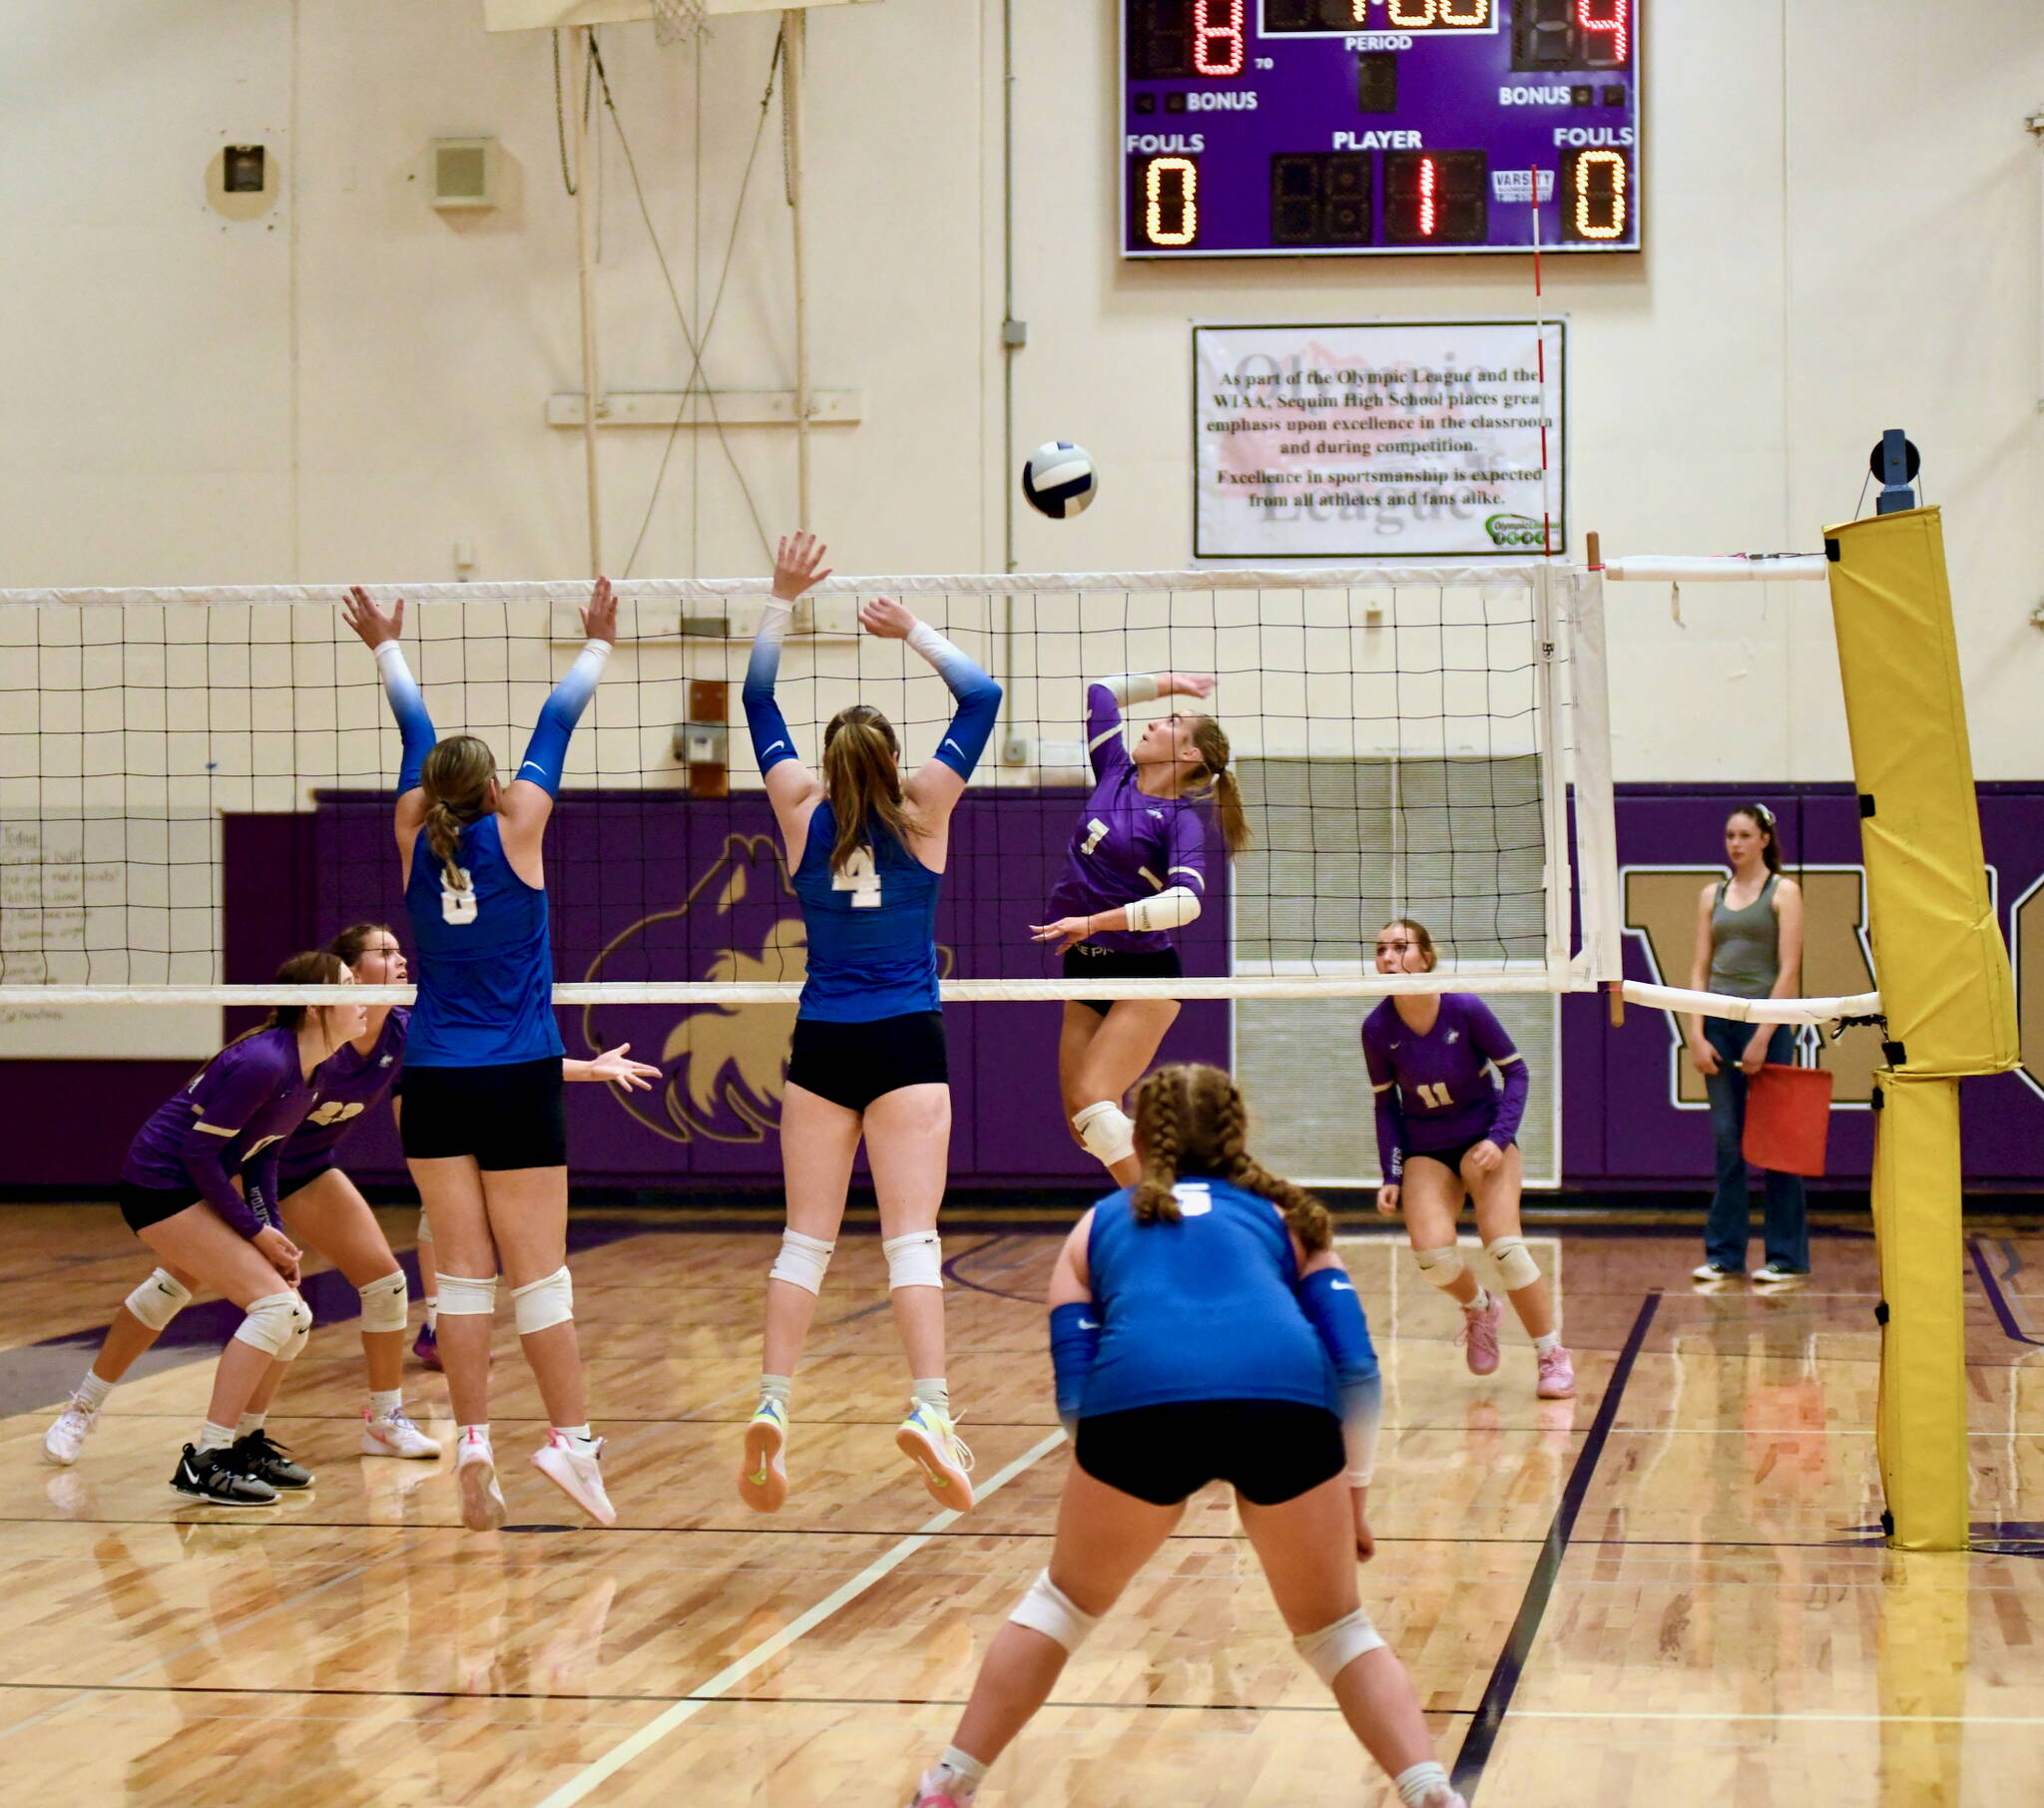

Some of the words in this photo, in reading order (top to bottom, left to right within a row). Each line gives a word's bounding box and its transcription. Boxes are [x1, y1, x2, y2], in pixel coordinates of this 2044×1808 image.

[1578, 0, 1626, 63] 4
[1345, 36, 1412, 51] PERIOD
[1255, 57, 1275, 71] 70
[1187, 92, 1258, 112] BONUS
[1499, 86, 1571, 106] BONUS
[1127, 133, 1205, 153] FOULS
[1332, 130, 1423, 150] PLAYER
[1553, 127, 1634, 147] FOULS
[1497, 173, 1550, 186] VARSTY
[1147, 158, 1197, 245] 0
[1420, 159, 1434, 235] 1
[1576, 151, 1625, 238] 0
[1221, 373, 1241, 385] As
[1245, 373, 1280, 389] part
[1286, 371, 1301, 385] of
[1307, 371, 1332, 384] the
[1336, 369, 1407, 387] Olympic
[1413, 369, 1472, 386] League
[1477, 368, 1507, 382] and
[1513, 368, 1539, 382] the
[1214, 394, 1272, 410] WIAA,
[1278, 395, 1337, 412] Sequim
[1343, 393, 1383, 409] High
[1389, 392, 1443, 406] School
[1448, 392, 1497, 409] places
[1503, 393, 1540, 408] grea
[1207, 417, 1281, 435] emphasis
[1286, 420, 1327, 435] upon
[1332, 416, 1414, 431] excellence
[1420, 415, 1435, 429] in
[1441, 415, 1467, 429] the
[1279, 440, 1310, 455] and
[1316, 439, 1371, 457] during
[1376, 437, 1478, 455] competition.
[1217, 469, 1301, 484] Excellence
[1307, 469, 1322, 484] in
[1328, 468, 1448, 485] sportsmanship
[1453, 469, 1467, 481] is
[1471, 468, 1542, 485] expected
[1249, 493, 1287, 507] from
[1293, 493, 1313, 506] all
[1318, 493, 1381, 506] athletes
[1387, 492, 1417, 505] and
[1423, 492, 1456, 505] fans
[1462, 491, 1506, 505] alike.
[831, 845, 881, 907] 4
[1416, 1082, 1454, 1109] 11
[1171, 1182, 1213, 1217] 5
